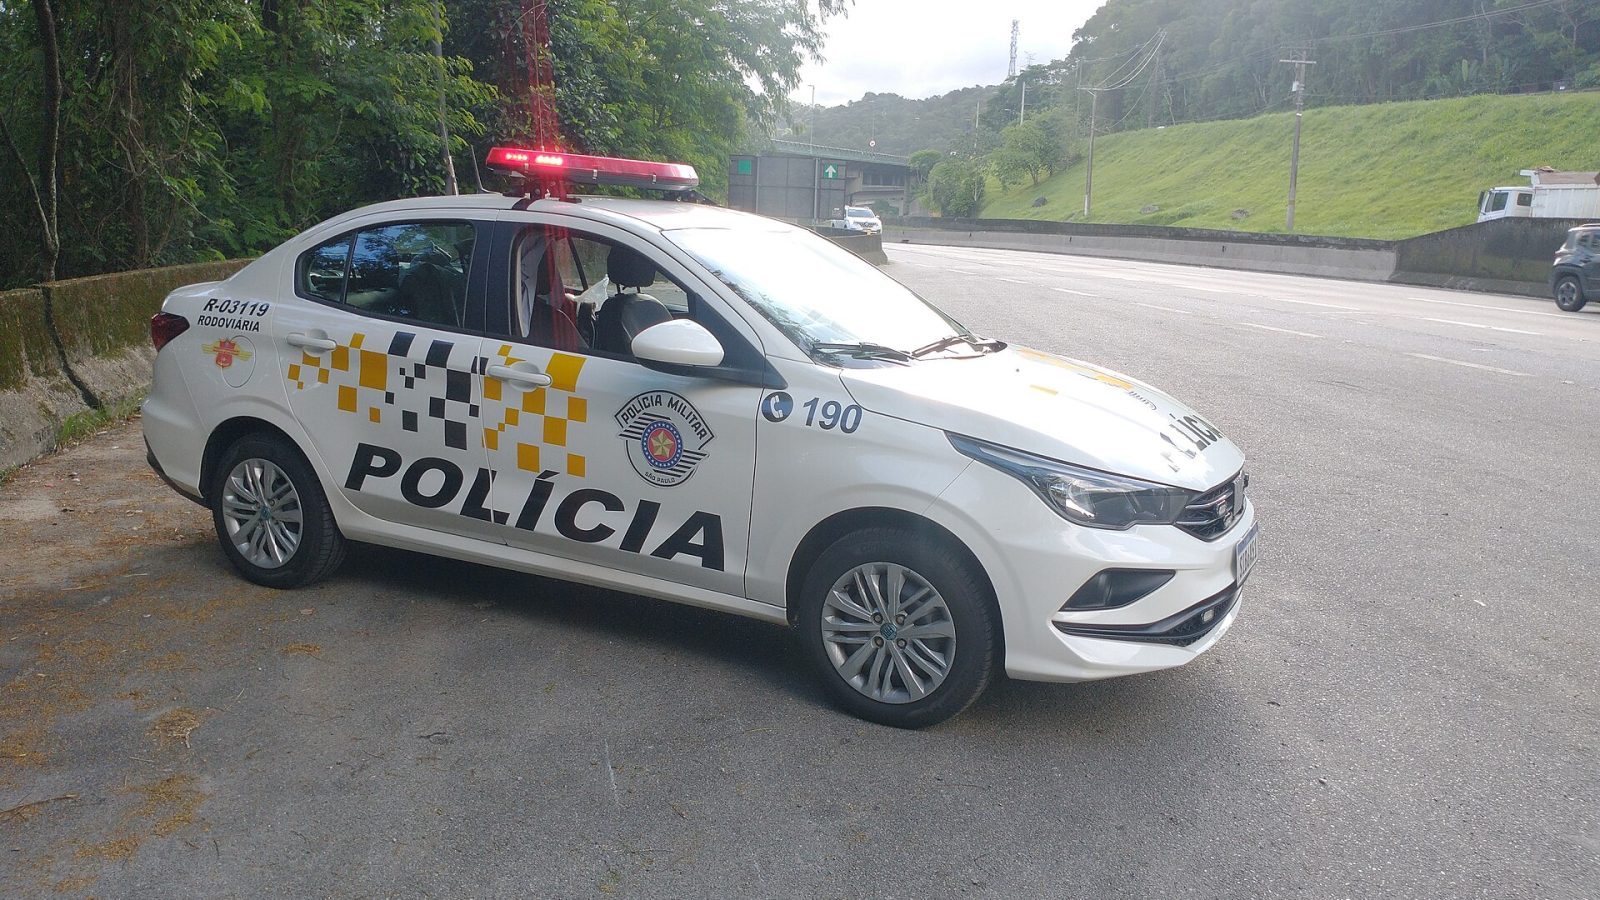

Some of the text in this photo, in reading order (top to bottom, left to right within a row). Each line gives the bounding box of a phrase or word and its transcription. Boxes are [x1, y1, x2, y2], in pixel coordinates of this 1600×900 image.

[197, 315, 260, 332] RODOVIÁRIA
[203, 298, 270, 317] R-03119
[620, 394, 708, 440] POLÍCIA MILITAR
[803, 397, 863, 434] 190
[344, 442, 725, 572] POLÍCIA
